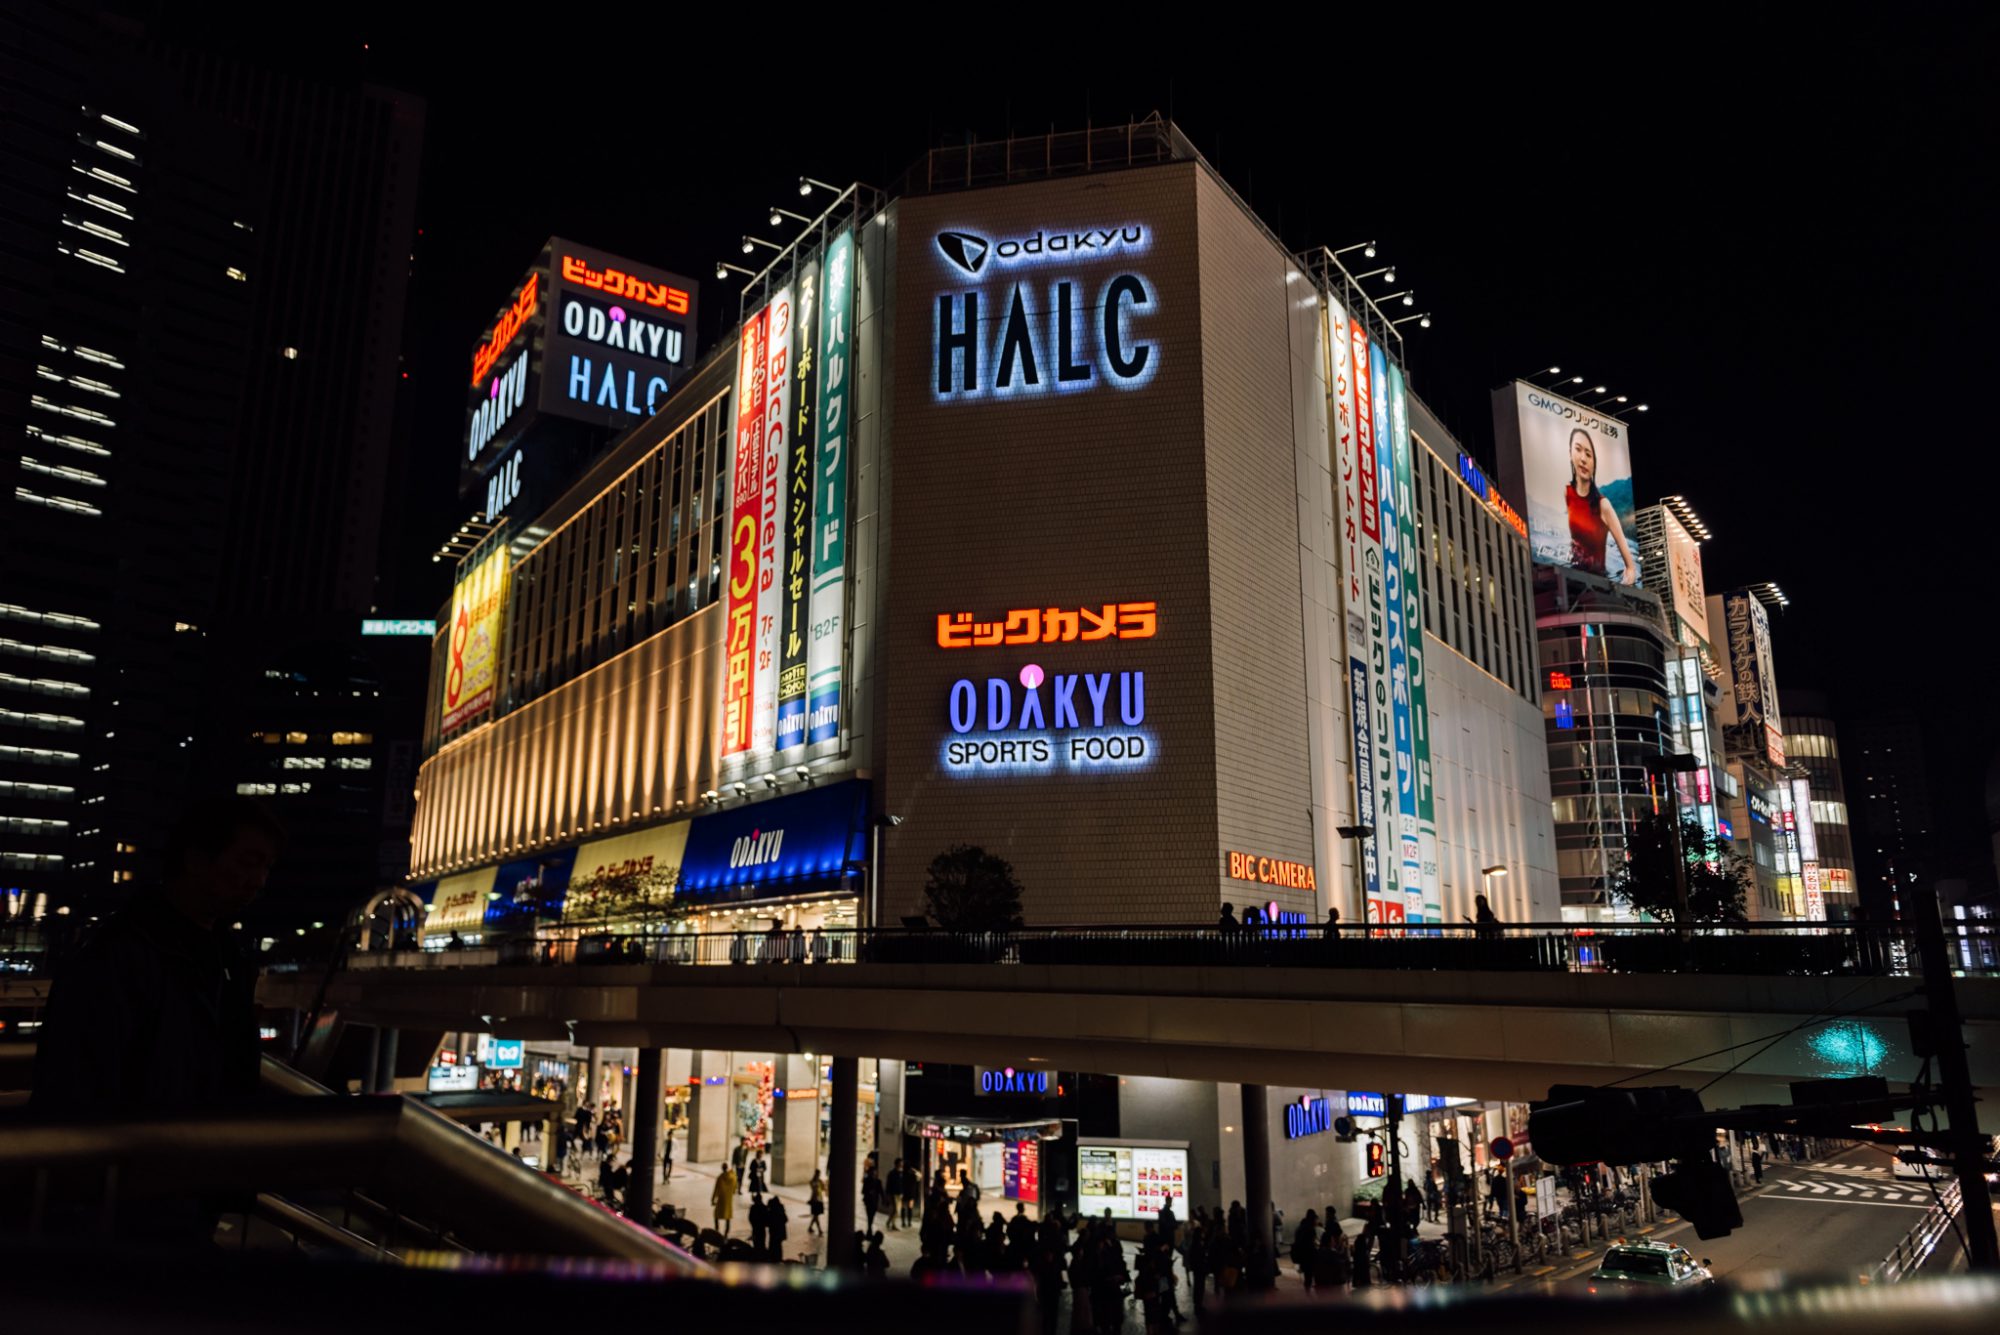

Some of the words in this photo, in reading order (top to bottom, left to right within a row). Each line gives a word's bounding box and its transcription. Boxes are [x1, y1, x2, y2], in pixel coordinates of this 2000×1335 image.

[997, 226, 1141, 258] odakyu
[562, 255, 689, 315] ビックカメラ
[472, 272, 538, 387] ビックカメラ
[564, 301, 682, 363] ODAKYU
[938, 274, 1149, 393] HALC
[469, 350, 528, 461] ODAKYU
[568, 355, 668, 416] HALC
[486, 449, 523, 523] HALC
[786, 446, 808, 659] スペシャルセール
[726, 515, 756, 749] 3万円引
[814, 616, 840, 641] B2F
[937, 602, 1156, 648] ビックカメラ
[759, 650, 772, 672] 2F
[1727, 596, 1762, 725] カラオケの鉄人
[950, 664, 1145, 734] ODAKYU
[948, 739, 1049, 766] SPORTS
[1071, 736, 1144, 761] FOOD
[1369, 577, 1399, 892] ビックのリフォーム
[730, 828, 784, 869] ODAKYU
[1230, 852, 1256, 881] BIC
[1258, 857, 1316, 891] CAMERA
[982, 1067, 1046, 1092] ODAKYU
[1289, 1095, 1330, 1140] ODAKYU
